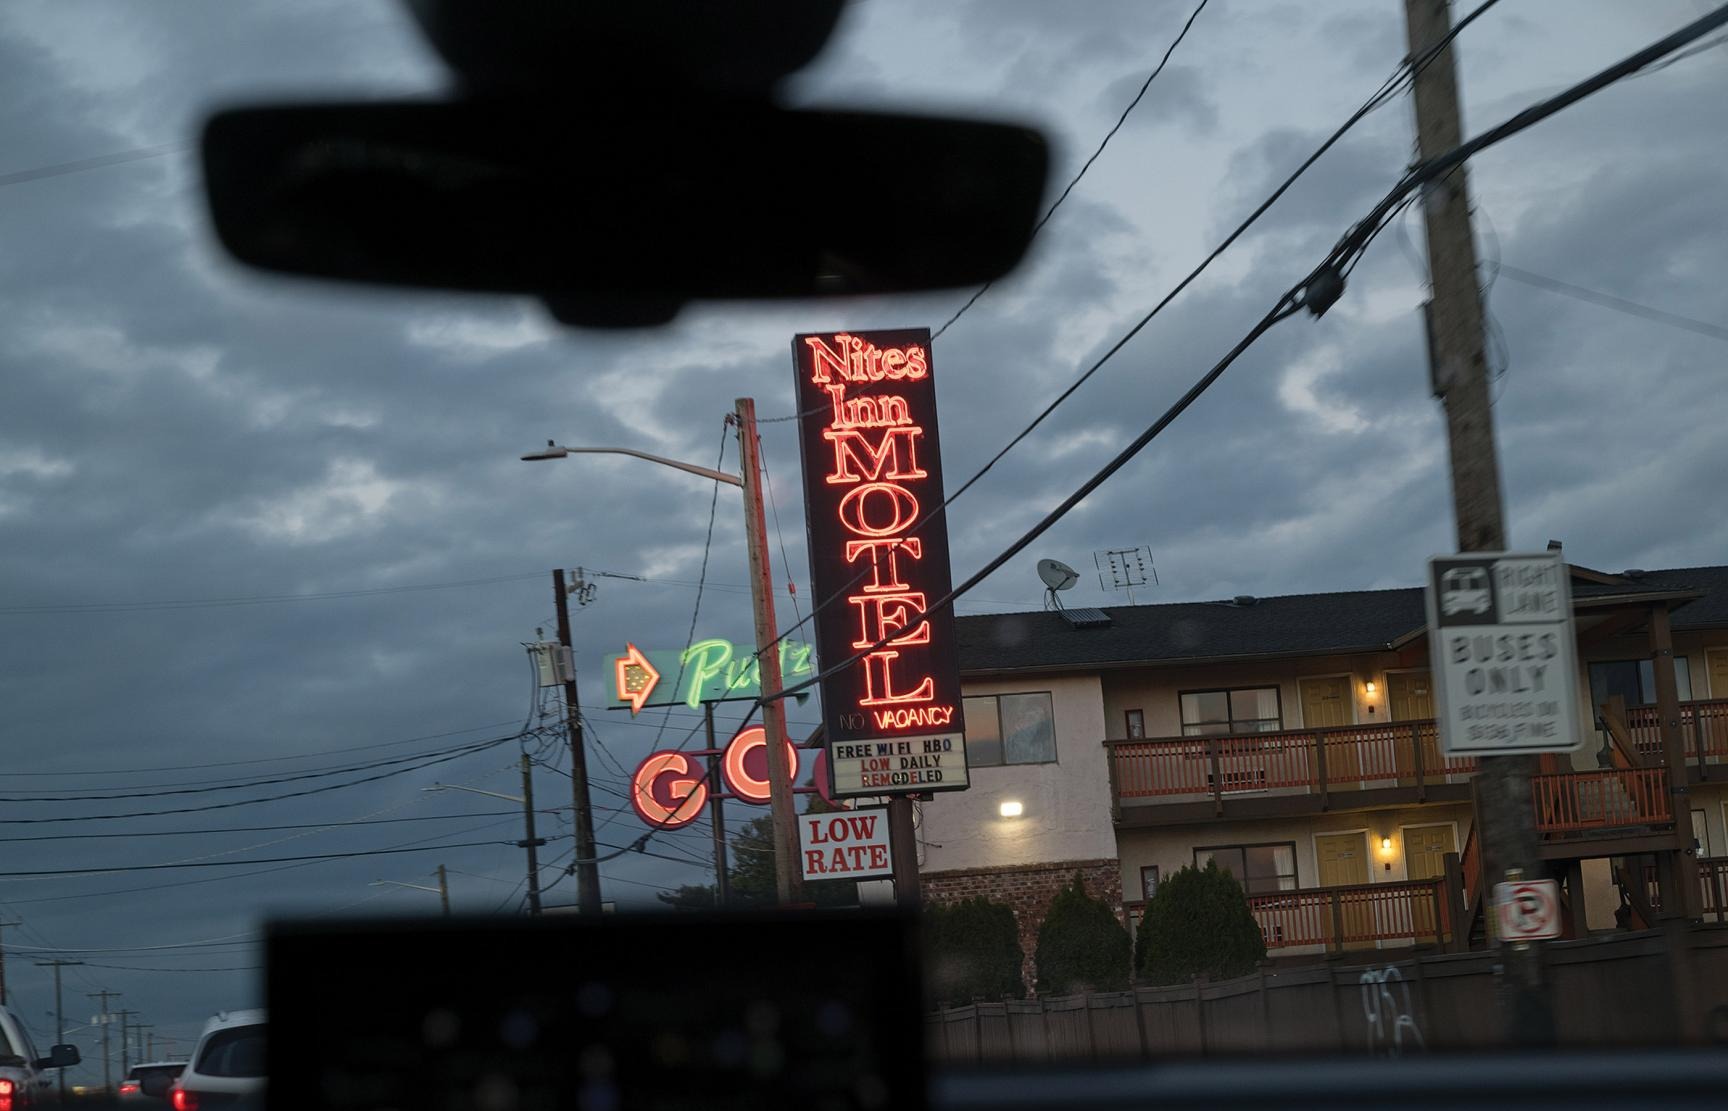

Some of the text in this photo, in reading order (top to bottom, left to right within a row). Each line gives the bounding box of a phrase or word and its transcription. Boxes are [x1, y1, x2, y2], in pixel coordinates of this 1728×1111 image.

[805, 334, 928, 384] Nites
[826, 383, 912, 429] Inn
[823, 426, 935, 706] MOTEL
[1451, 632, 1557, 664] BUSES
[680, 638, 813, 710] Putz
[1465, 664, 1549, 695] ONLY
[839, 713, 864, 730] NO
[836, 744, 873, 759] FREE
[923, 738, 952, 754] HBO
[861, 755, 941, 772] LOW DAILY
[862, 770, 943, 788] REMODELED
[809, 816, 877, 844] LOW
[805, 844, 888, 874] RATE
